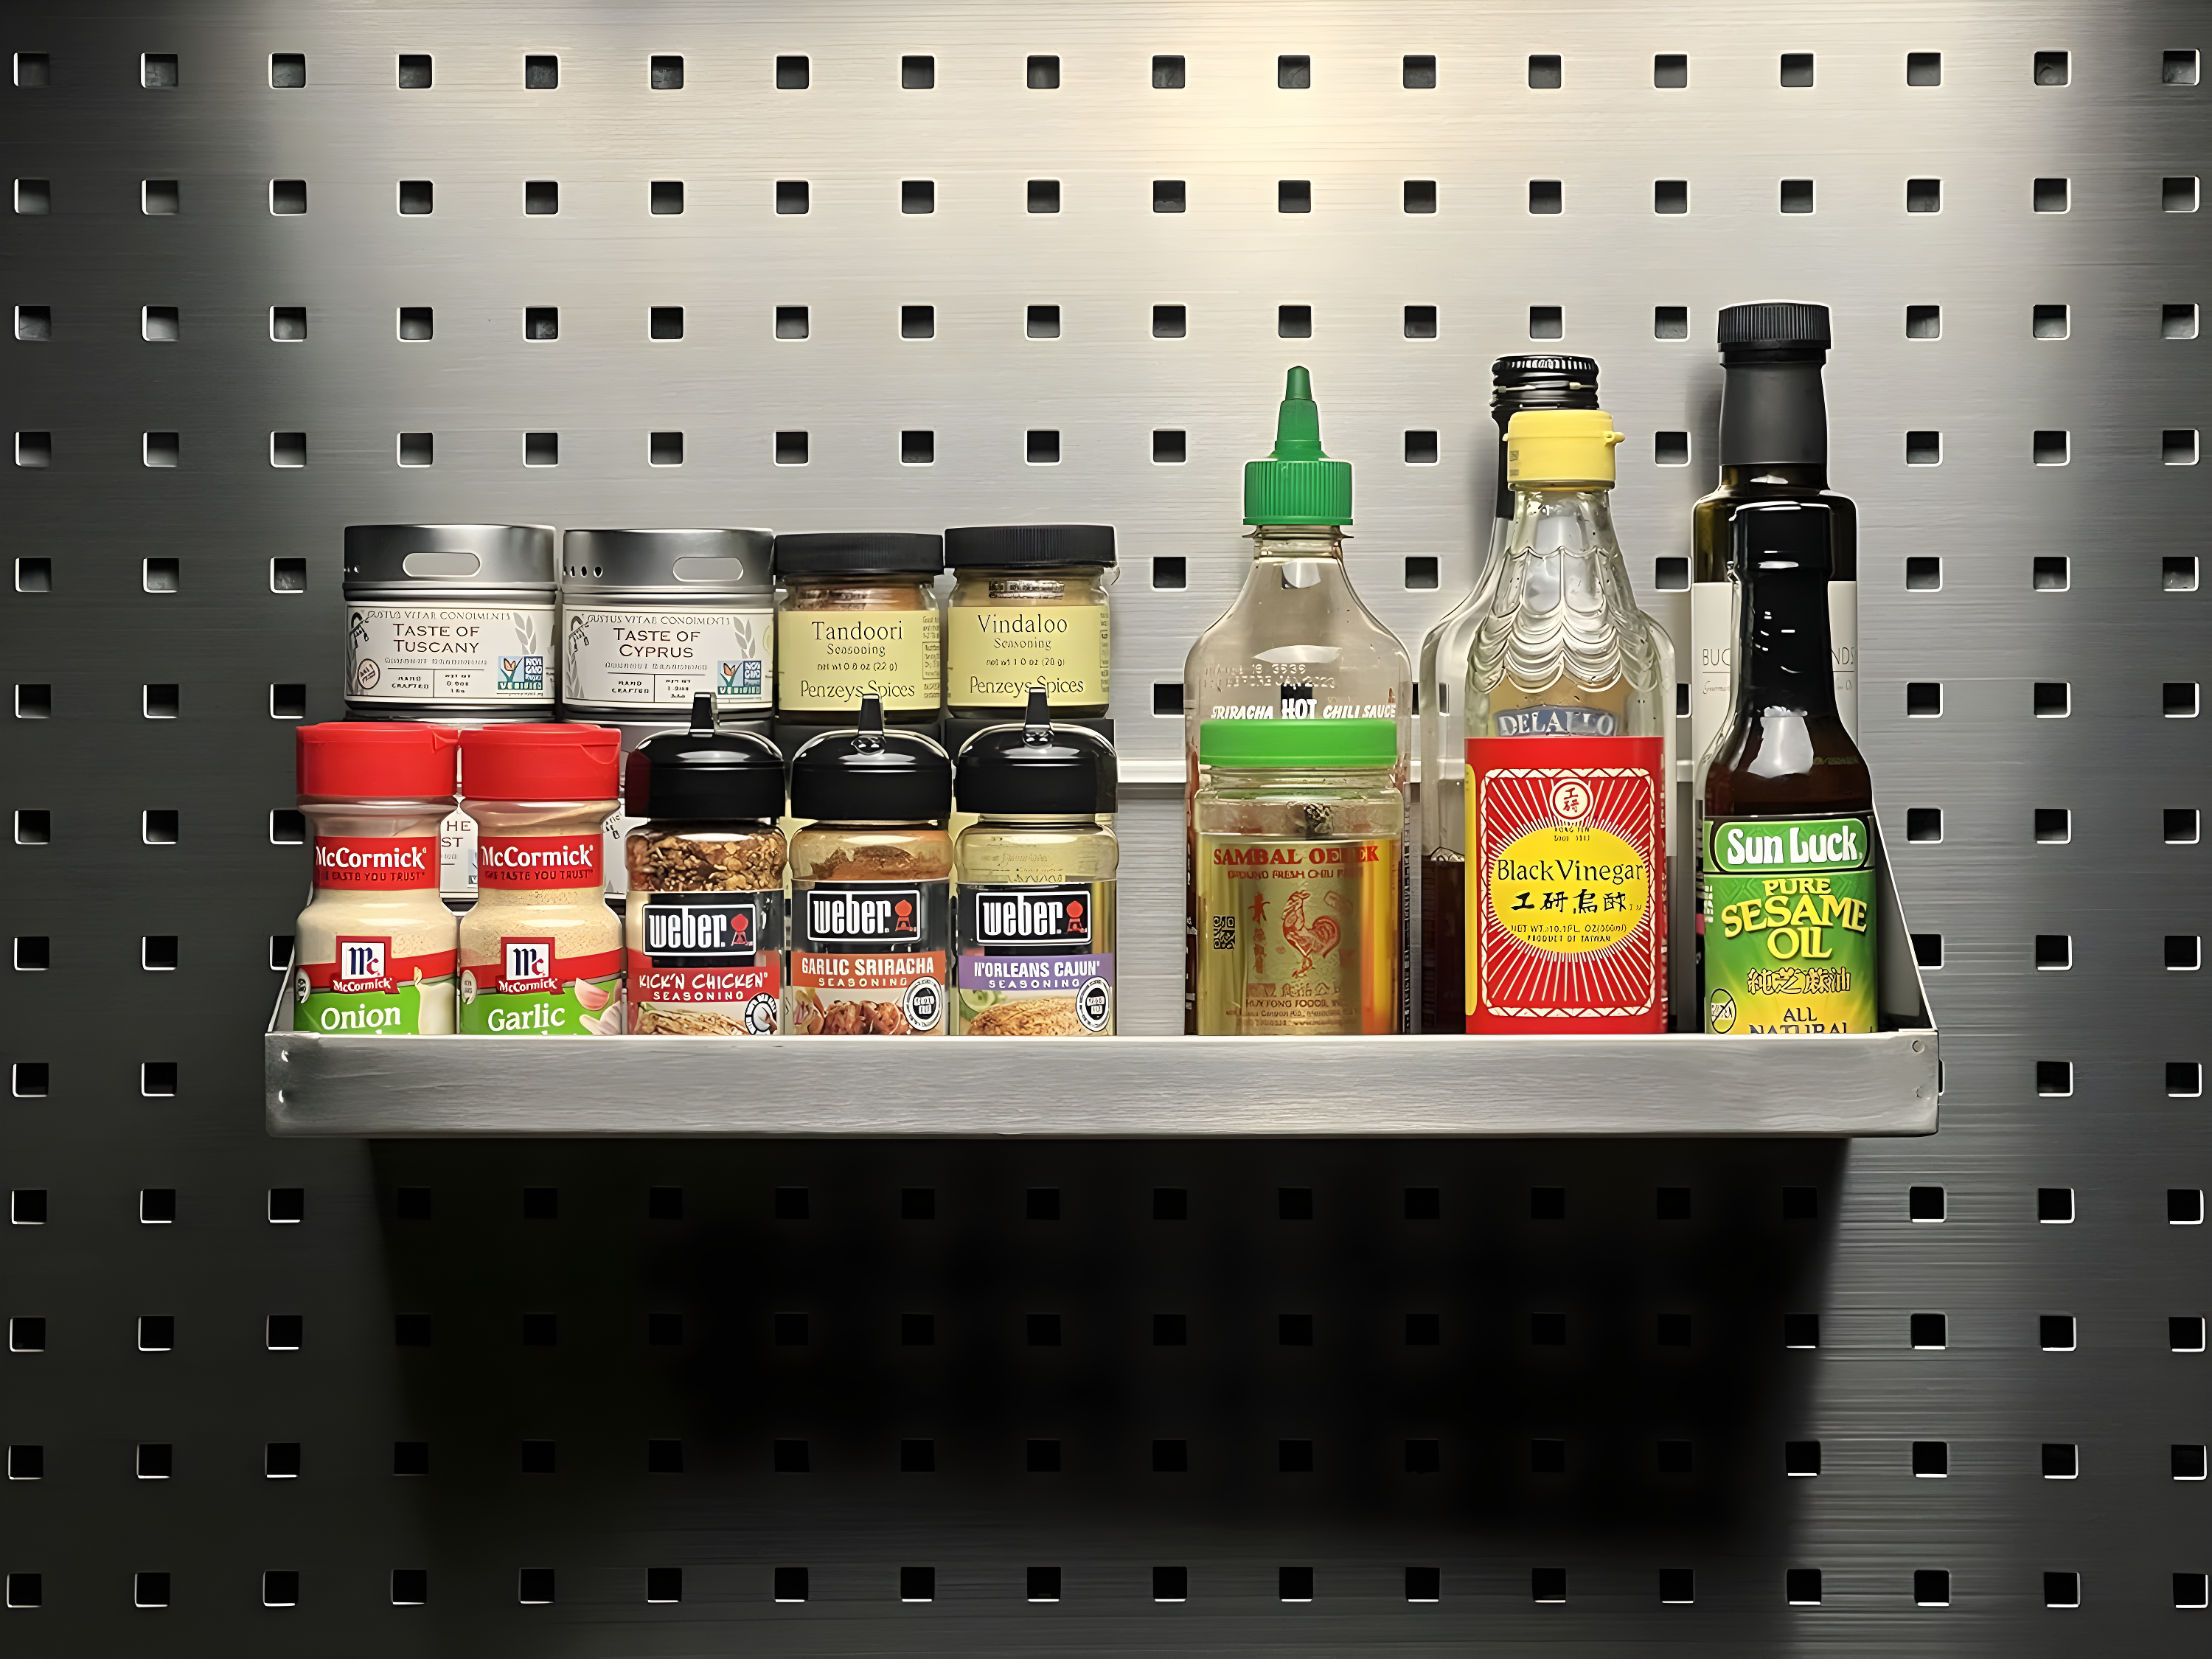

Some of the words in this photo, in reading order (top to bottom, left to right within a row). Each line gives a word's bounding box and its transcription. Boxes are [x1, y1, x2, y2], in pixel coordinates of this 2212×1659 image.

[393, 623, 450, 636] TASTE
[456, 626, 480, 636] OF
[811, 620, 903, 641] Tandoori
[978, 613, 1068, 633] Vindaloo
[613, 627, 671, 641] TASTE
[676, 630, 700, 642] OF
[393, 639, 479, 653] TUSCANY
[619, 644, 693, 658] CYPRUS
[827, 642, 886, 656] Seasoning
[993, 637, 1051, 650] Seasoning
[801, 680, 863, 702] Penzeys
[868, 680, 915, 699] Spices
[970, 675, 1032, 698] Penzeys
[1037, 675, 1084, 698] Spices
[1210, 705, 1273, 720] SRIRACHA
[1281, 698, 1318, 720] HOT
[1322, 705, 1360, 719] CHILI
[1361, 703, 1396, 718] SAUCE
[1727, 828, 1784, 865] Sun
[1790, 825, 1858, 864] Luck
[316, 846, 427, 870] McCormick
[481, 844, 593, 868] McCormick
[1213, 848, 1303, 865] SAMBAL
[364, 872, 386, 881] YOU
[391, 872, 422, 881] TRUST
[535, 871, 556, 880] YOU
[560, 870, 590, 880] TRUST
[1497, 859, 1554, 881] Black
[1554, 859, 1643, 885] Vinegar
[1762, 877, 1832, 896] PURE
[1721, 894, 1868, 939] SESAME
[1767, 926, 1833, 960] OIL
[801, 957, 849, 975] GARLIC
[855, 957, 934, 975] SRIRACHA
[974, 961, 1050, 978] N'ORLEANS
[333, 977, 392, 992] McCormick
[498, 978, 558, 992] McCormick
[639, 973, 685, 990] KICK'N
[692, 973, 763, 990] CHICKEN
[818, 977, 907, 987] SEASONING
[988, 978, 1080, 989] SEASONING
[653, 990, 744, 1001] SEASONING
[321, 1004, 400, 1030] Onion
[487, 1003, 566, 1031] Garlic
[1783, 1006, 1818, 1023] ALL
[1748, 1022, 1848, 1034] NATURAL
